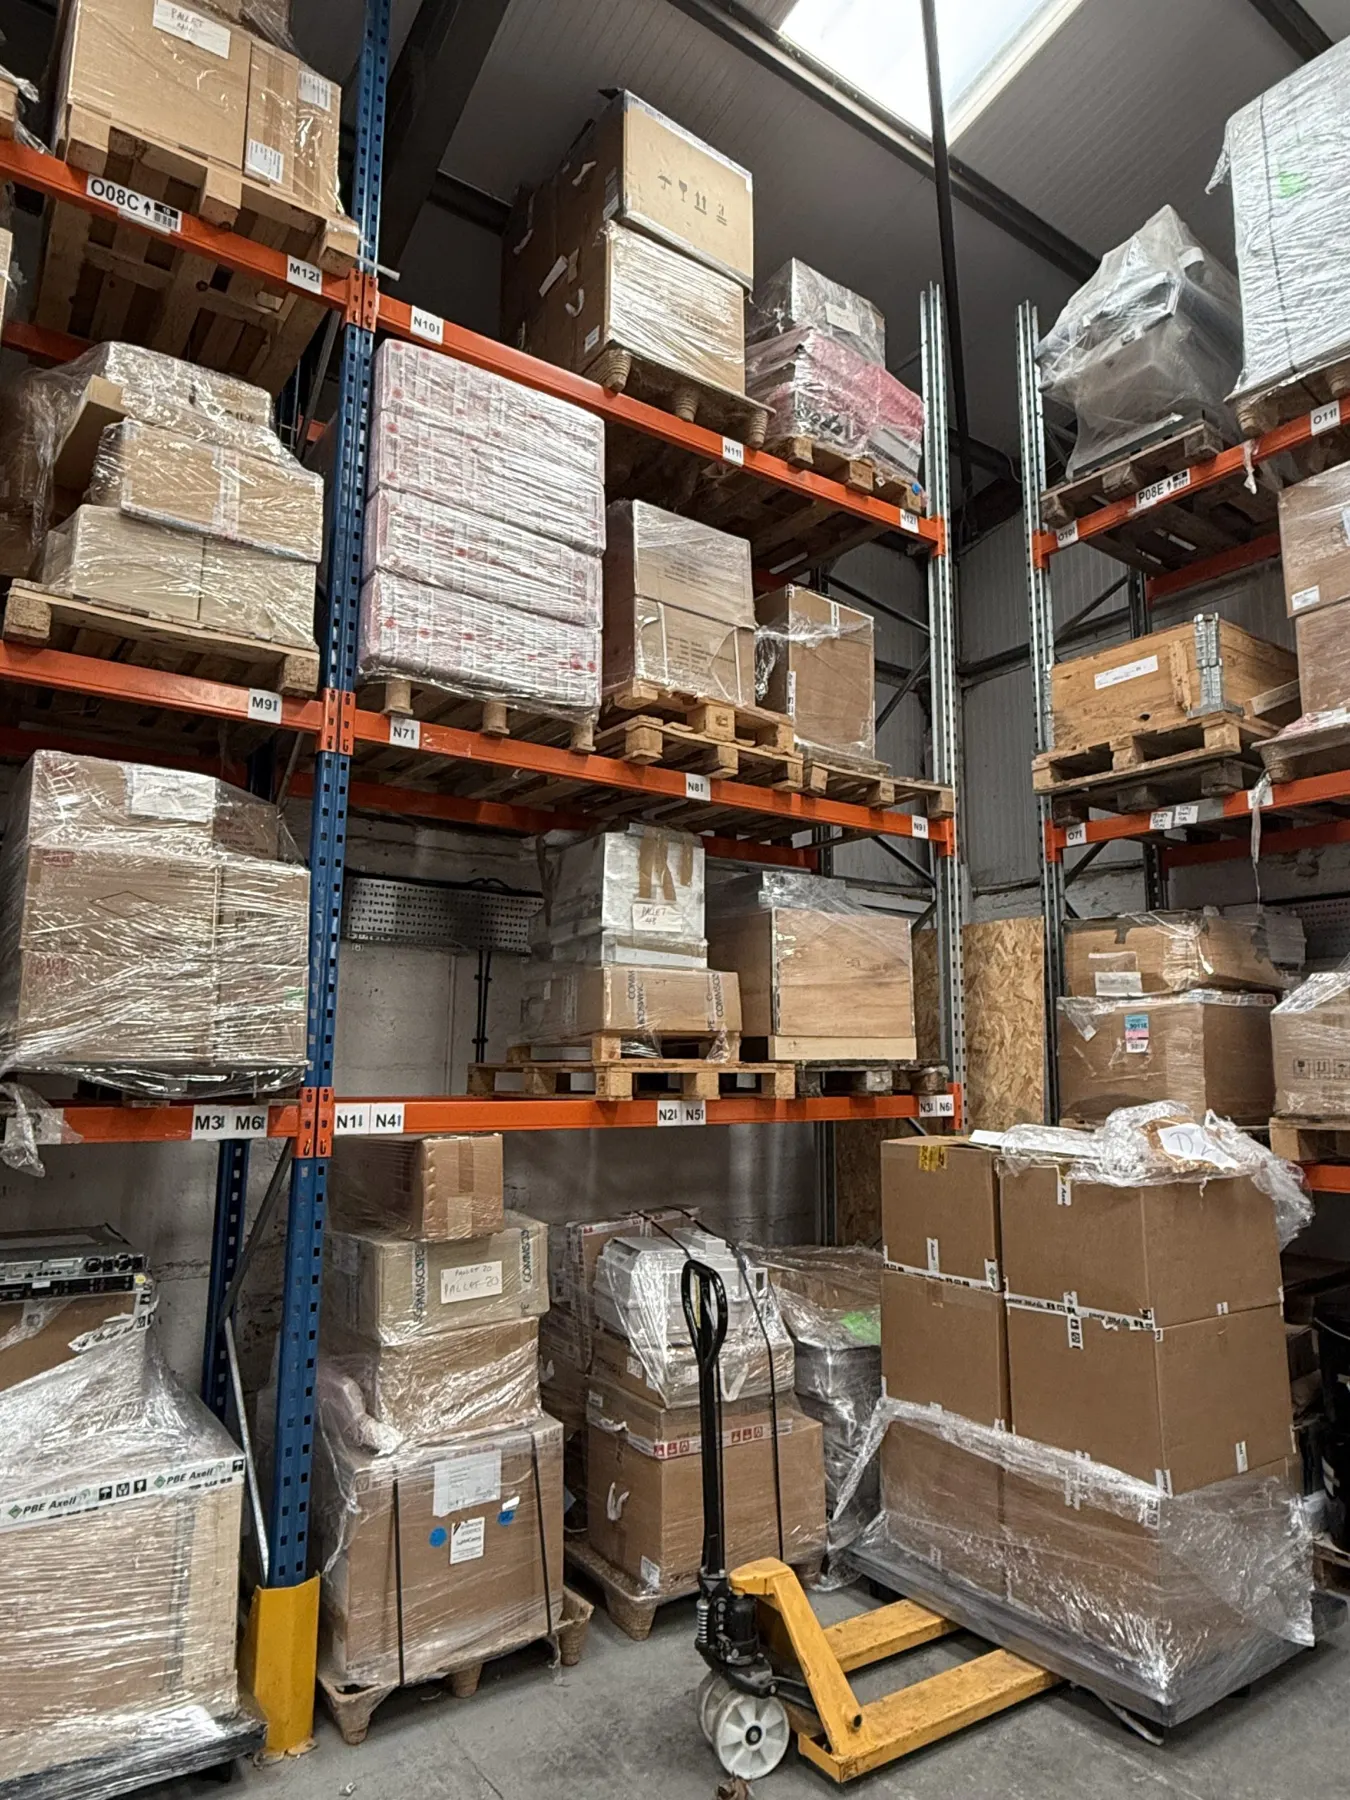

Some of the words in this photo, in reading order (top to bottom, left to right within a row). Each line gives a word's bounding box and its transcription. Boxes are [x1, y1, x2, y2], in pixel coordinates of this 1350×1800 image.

[91, 179, 140, 211] O08C
[1137, 485, 1165, 504] P08E
[166, 1472, 186, 1485] PBE
[189, 1467, 214, 1481] Axell
[22, 1503, 46, 1515] PBE
[48, 1496, 77, 1510] Axell
